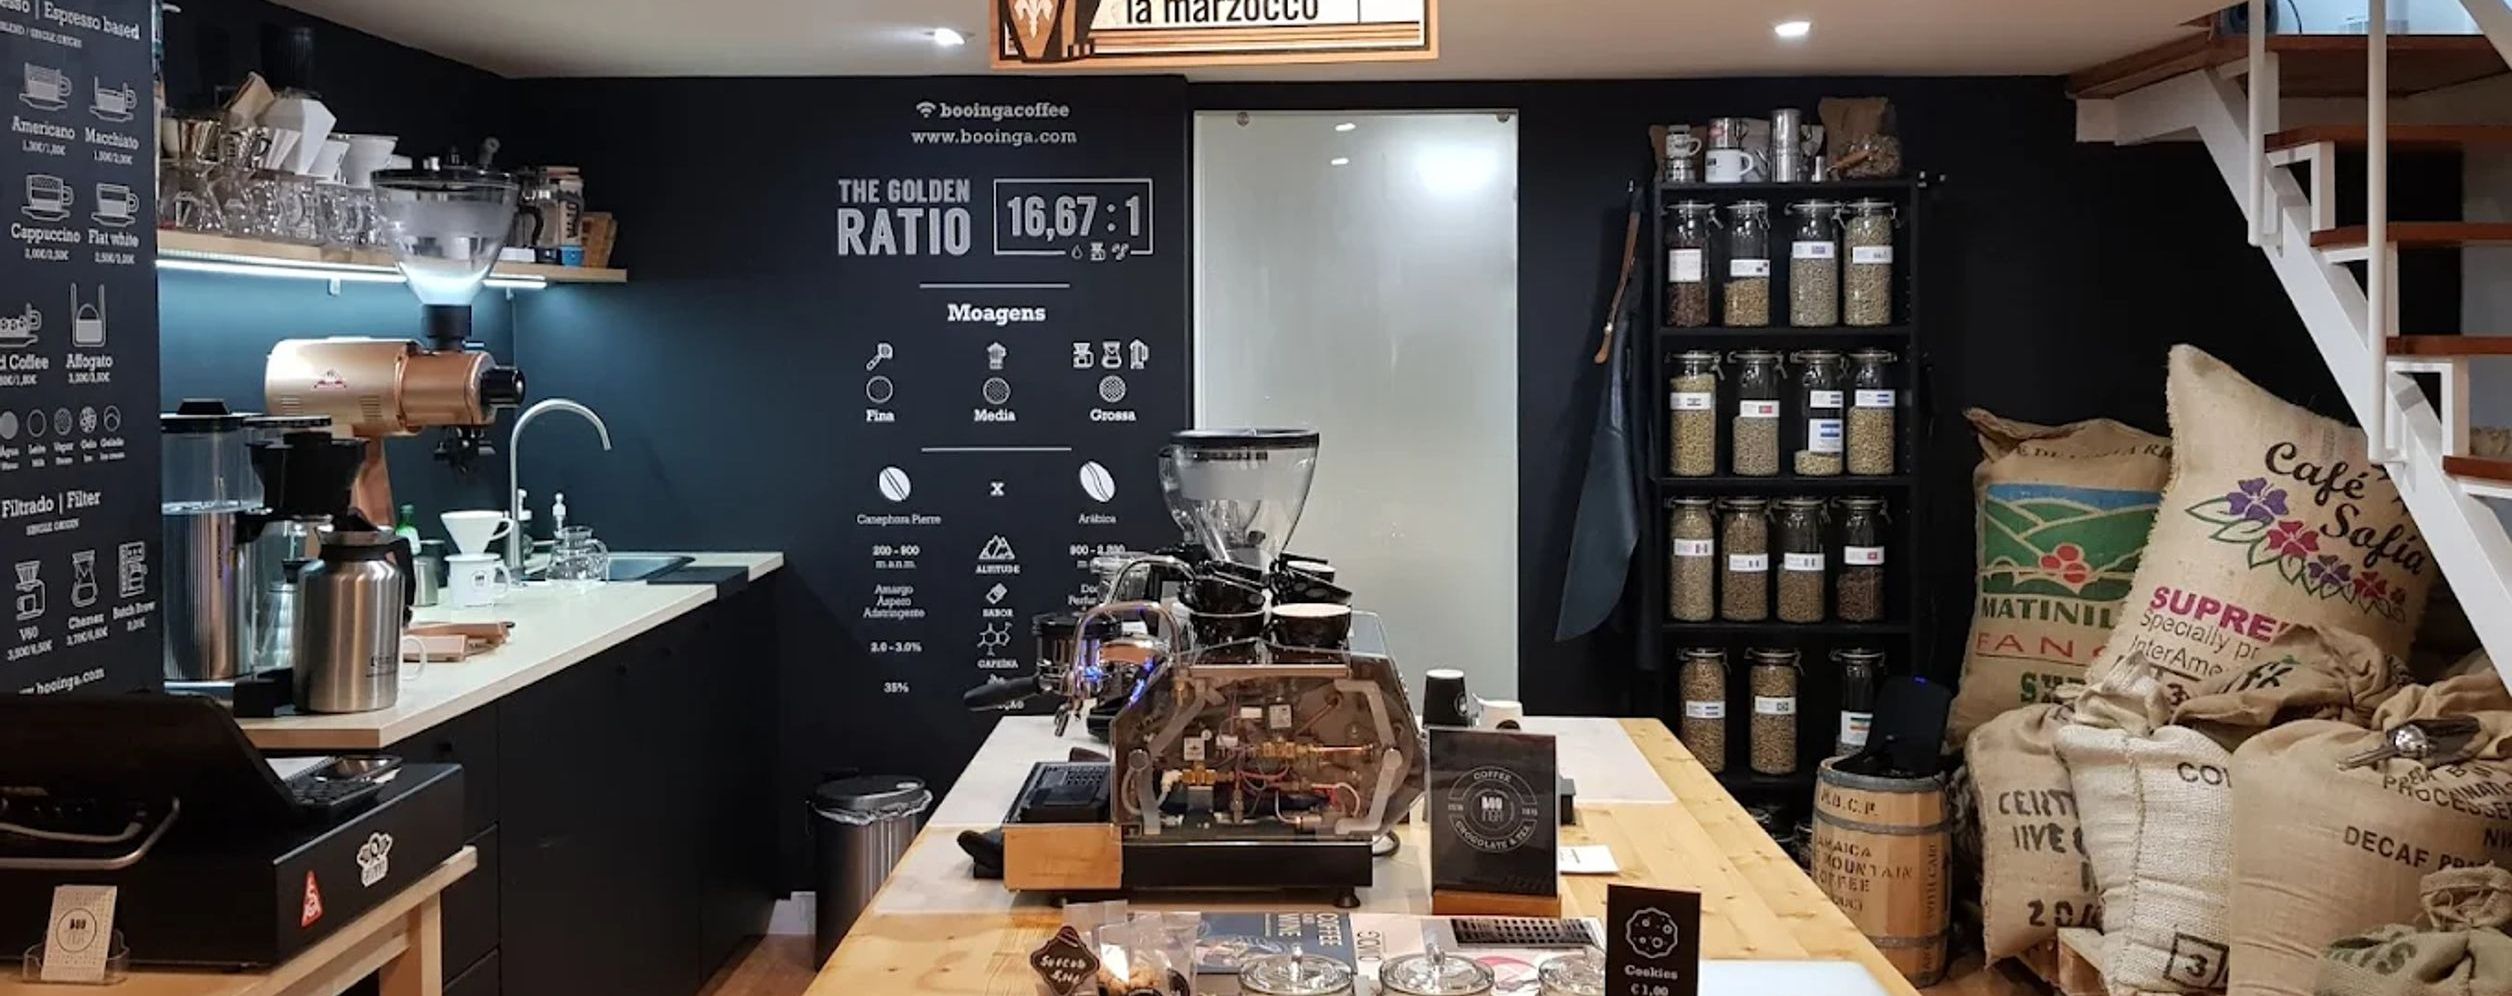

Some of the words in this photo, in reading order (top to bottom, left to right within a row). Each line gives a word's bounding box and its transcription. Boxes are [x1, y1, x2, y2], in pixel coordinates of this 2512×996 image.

[44, 1, 101, 30] Espresso
[104, 16, 140, 39] based
[1126, 0, 1152, 24] la
[1163, 1, 1318, 23] marzocco
[940, 102, 1070, 121] booingacoffee
[12, 116, 75, 140] Americano
[85, 127, 139, 150] Macchiato
[912, 128, 1078, 146] www.booinga.com
[838, 179, 880, 203] THE
[888, 179, 971, 203] GOLDEN
[1007, 195, 1098, 242] 16,67
[1126, 195, 1140, 237] 1
[11, 223, 81, 244] Cappuccino
[88, 229, 109, 245] Flat
[110, 231, 140, 248] white
[837, 208, 972, 256] RATIO
[948, 303, 1046, 326] Moagens
[9, 354, 49, 370] Coffee
[66, 353, 113, 371] Affogato
[866, 409, 895, 422] Fina
[974, 409, 1016, 422] Media
[1090, 409, 1136, 422] Grossa
[2265, 441, 2369, 507] Café
[2, 495, 54, 519] Filtrado
[66, 490, 102, 509] Filter
[912, 514, 941, 525] Pierre
[976, 565, 1020, 574] ALTITUDE
[874, 584, 914, 596] Amargo
[983, 609, 1013, 618] SABOR
[2150, 585, 2291, 644] SUPRE
[2140, 608, 2230, 654] Specially
[1473, 770, 1512, 783] COFFEE
[2383, 774, 2512, 820] PROCESSE
[1455, 820, 1508, 850] CHOCOLATE
[1817, 836, 1872, 857] AMAICA
[2344, 825, 2429, 869] DECAF
[1823, 853, 1913, 879] MOUNTAIN
[1819, 871, 1871, 893] OFFEE
[1624, 964, 1678, 980] Cookies
